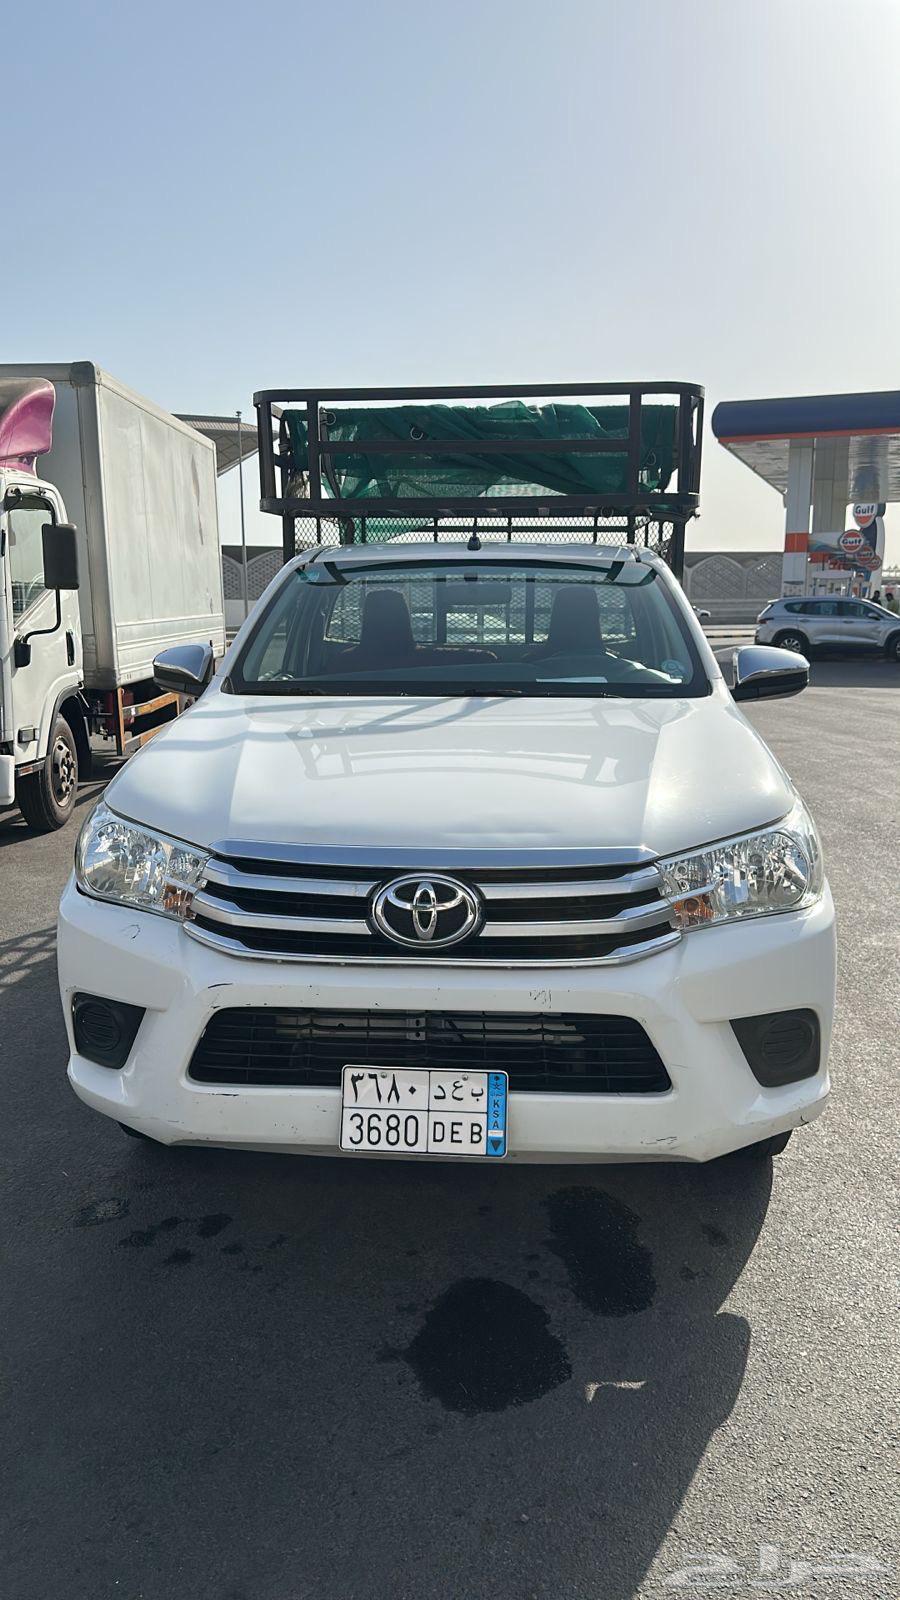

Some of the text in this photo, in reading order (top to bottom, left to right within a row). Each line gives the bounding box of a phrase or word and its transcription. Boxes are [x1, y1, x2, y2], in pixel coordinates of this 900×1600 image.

[855, 505, 874, 514] Gulf
[351, 1073, 417, 1103] ٣٦٨٠
[350, 1113, 418, 1147] 3680
